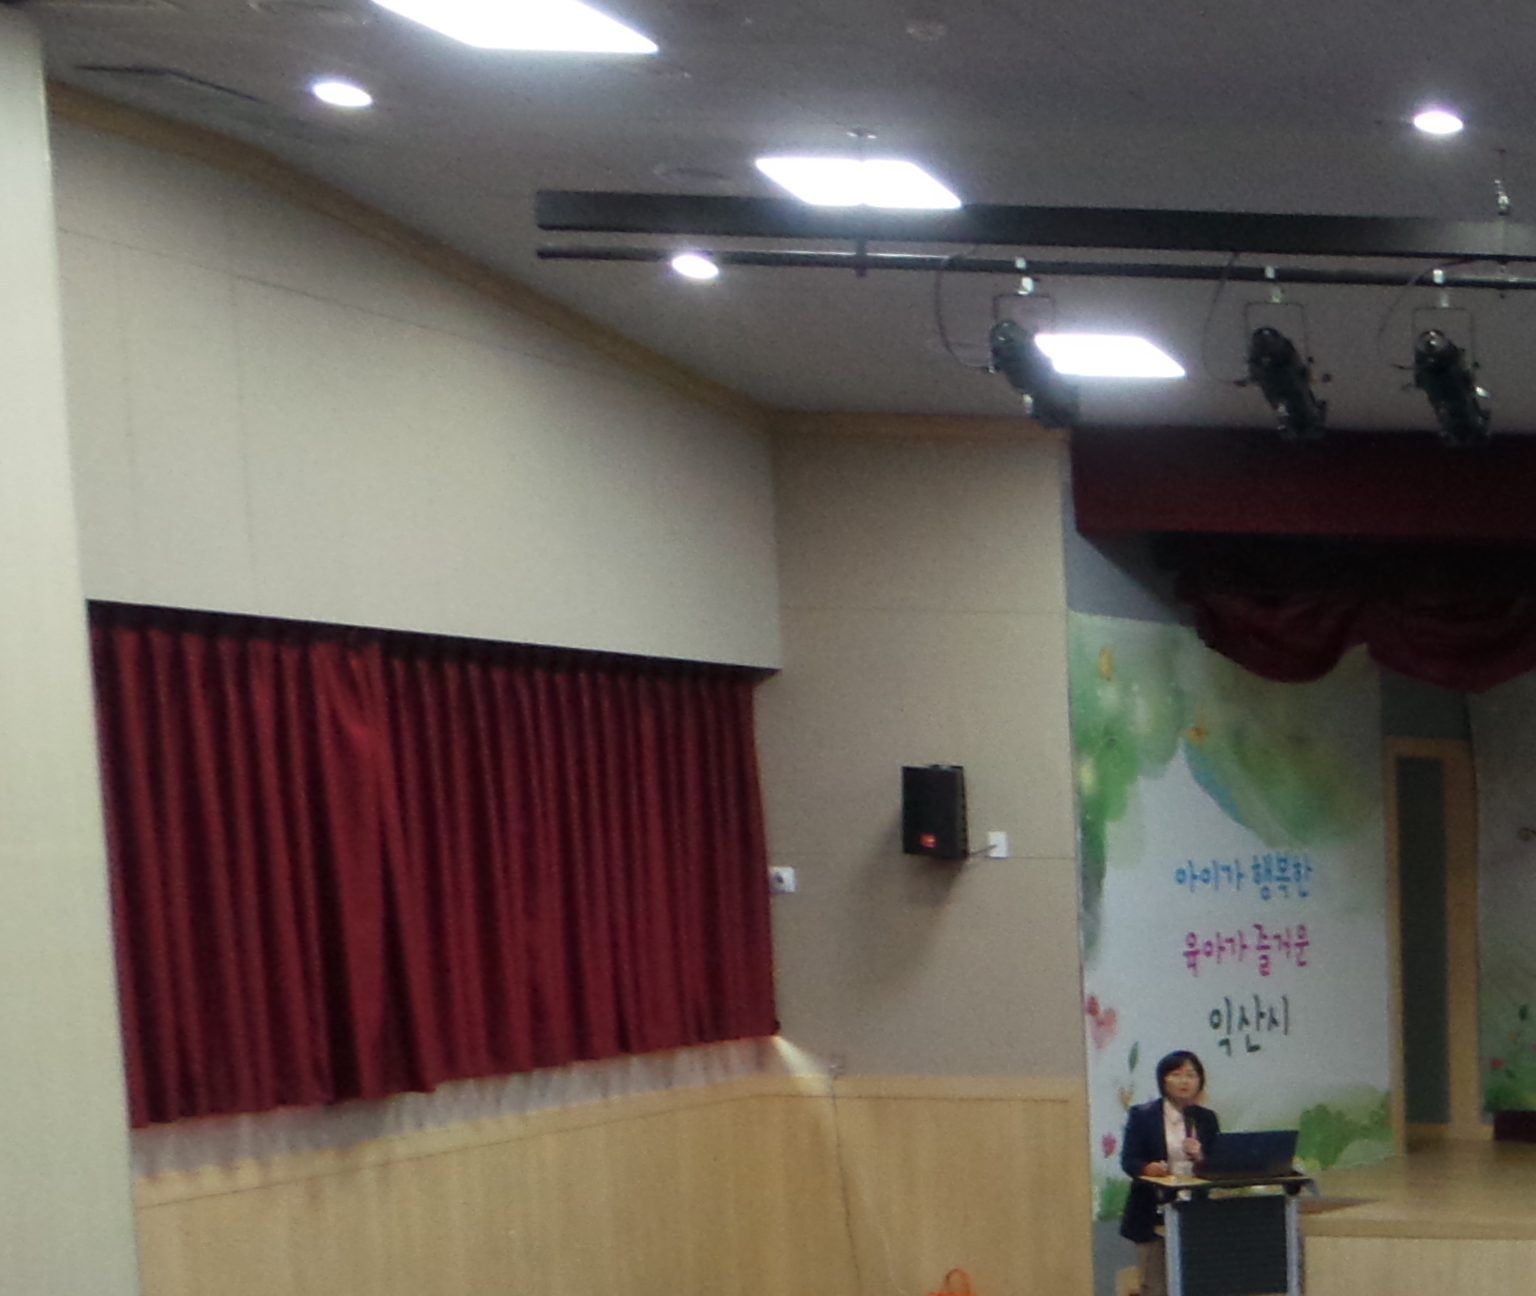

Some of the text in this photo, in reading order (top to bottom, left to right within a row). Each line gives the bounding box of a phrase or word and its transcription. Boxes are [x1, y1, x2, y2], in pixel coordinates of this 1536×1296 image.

[1174, 852, 1314, 901] 아이가 행복한
[1183, 922, 1311, 978] 육아가 즐거운
[1208, 993, 1290, 1058] 익산시
